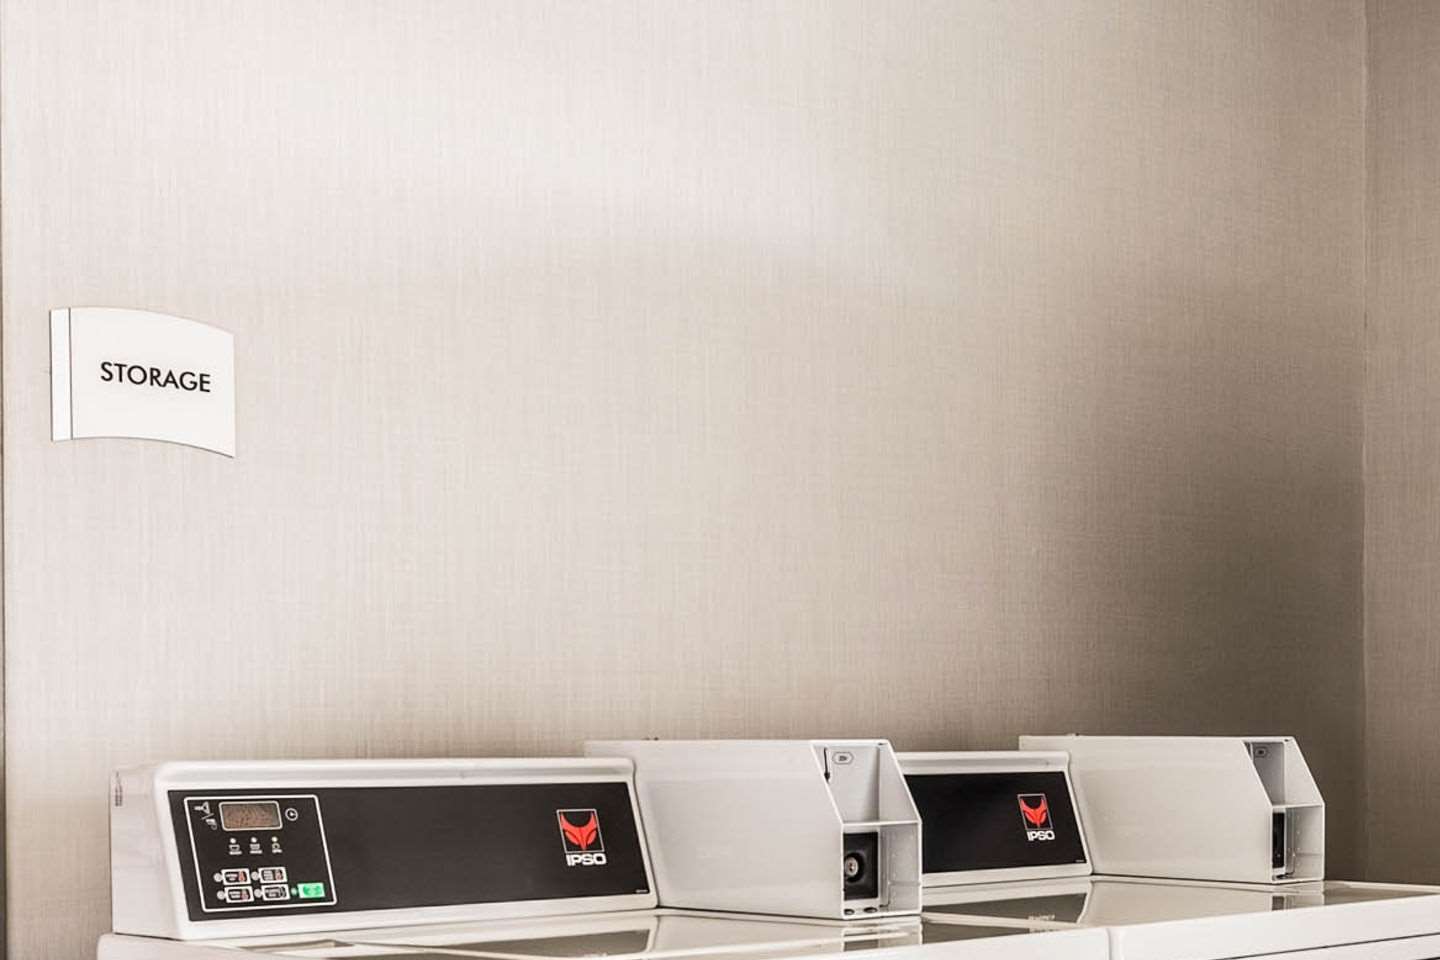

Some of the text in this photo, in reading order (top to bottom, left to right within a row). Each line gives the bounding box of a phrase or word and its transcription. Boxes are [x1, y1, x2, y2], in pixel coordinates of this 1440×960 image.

[100, 361, 211, 392] STORAGE
[1027, 830, 1055, 841] IPSO
[566, 853, 606, 866] IPSO
